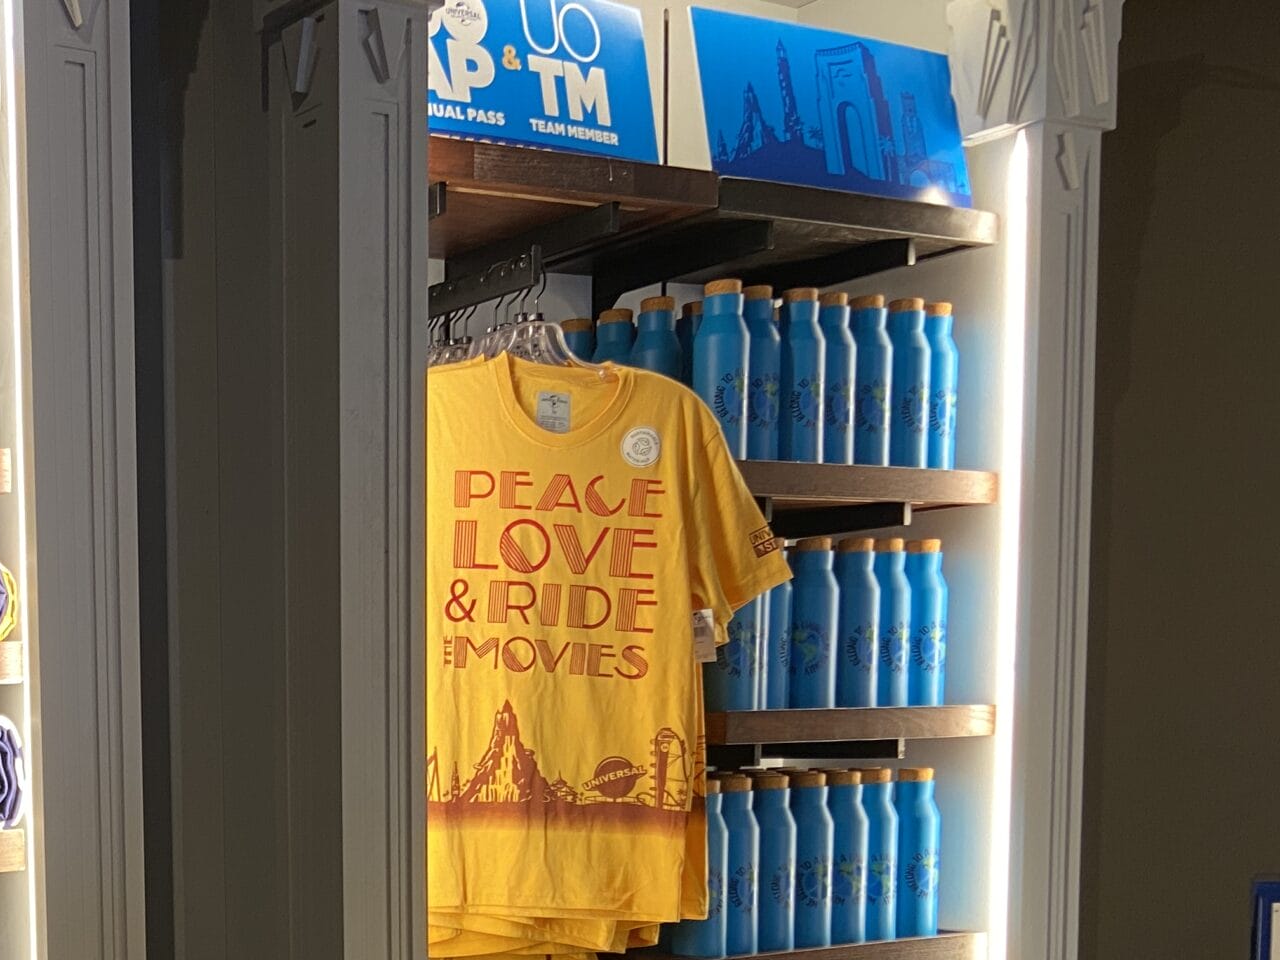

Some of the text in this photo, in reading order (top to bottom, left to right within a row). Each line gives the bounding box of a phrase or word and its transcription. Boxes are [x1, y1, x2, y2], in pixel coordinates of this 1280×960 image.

[527, 54, 612, 127] TM
[467, 108, 506, 127] PASS
[529, 118, 565, 137] TEAM
[567, 125, 619, 146] MEMBER
[454, 470, 665, 518] PEACE
[453, 519, 658, 579] LOVE
[444, 578, 658, 633] & RIDE
[454, 636, 649, 680] MOVIES
[583, 766, 646, 790] UNIVERSAL
